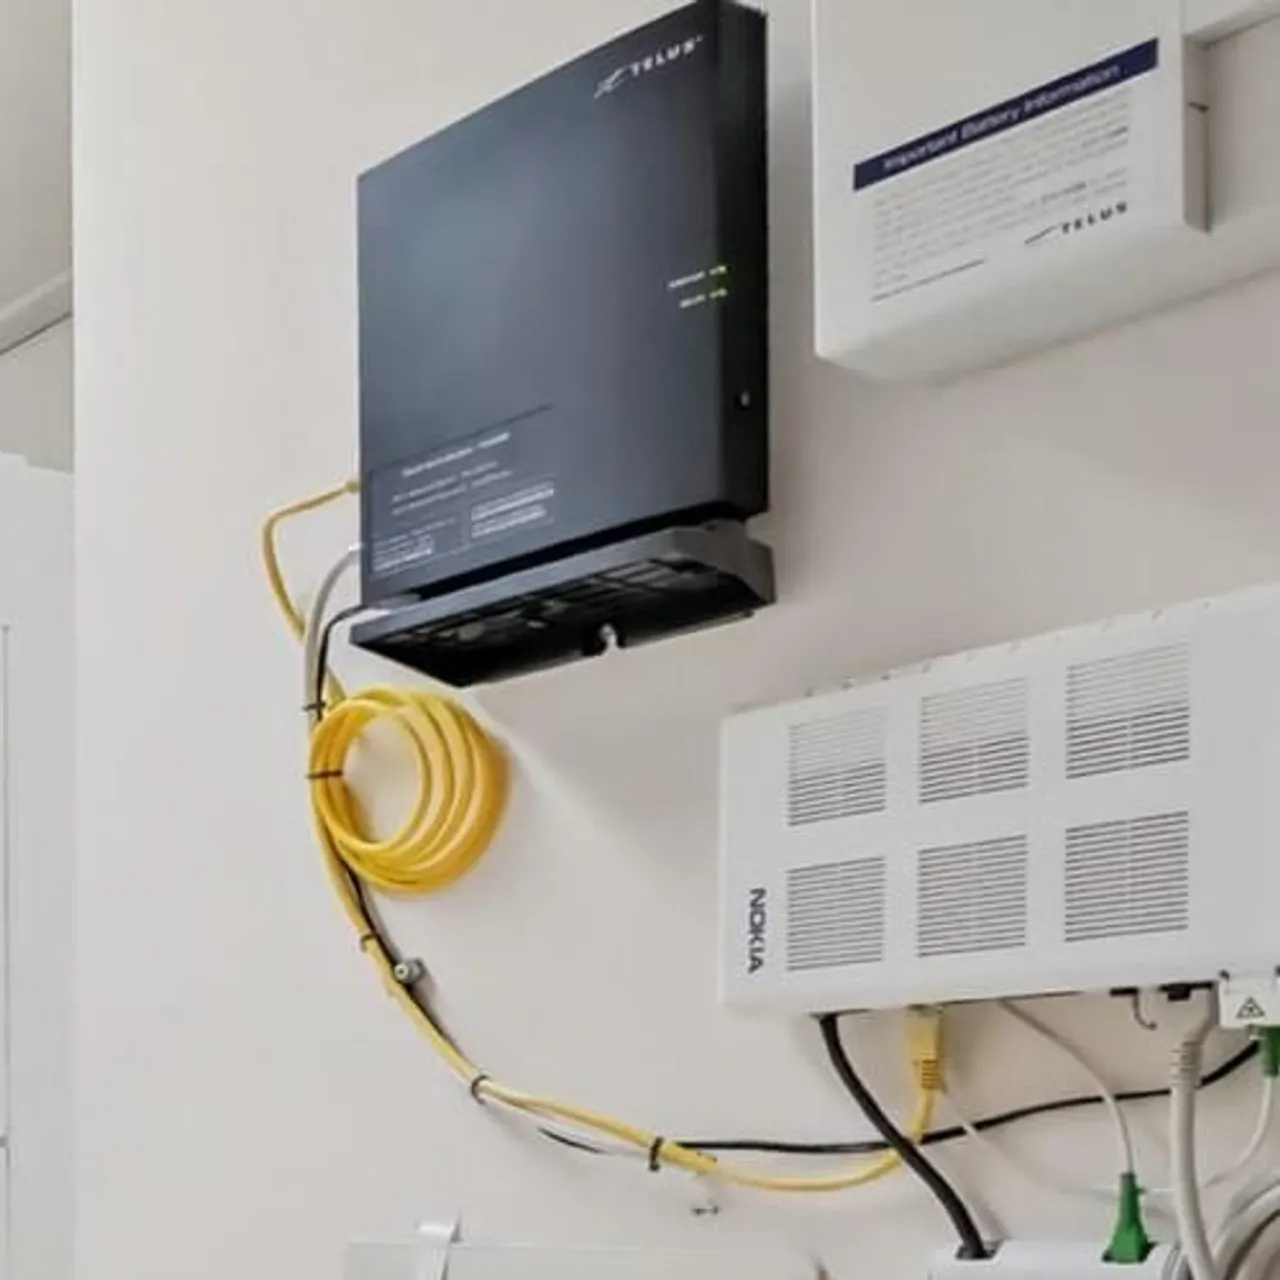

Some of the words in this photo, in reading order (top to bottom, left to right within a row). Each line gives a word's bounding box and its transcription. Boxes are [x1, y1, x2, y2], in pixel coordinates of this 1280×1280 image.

[630, 38, 697, 78] TELUS
[882, 130, 958, 171] Important
[960, 106, 1022, 140] Battery
[1023, 64, 1121, 114] Information
[1061, 201, 1128, 235] TELUS
[749, 887, 766, 974] NOKIA
